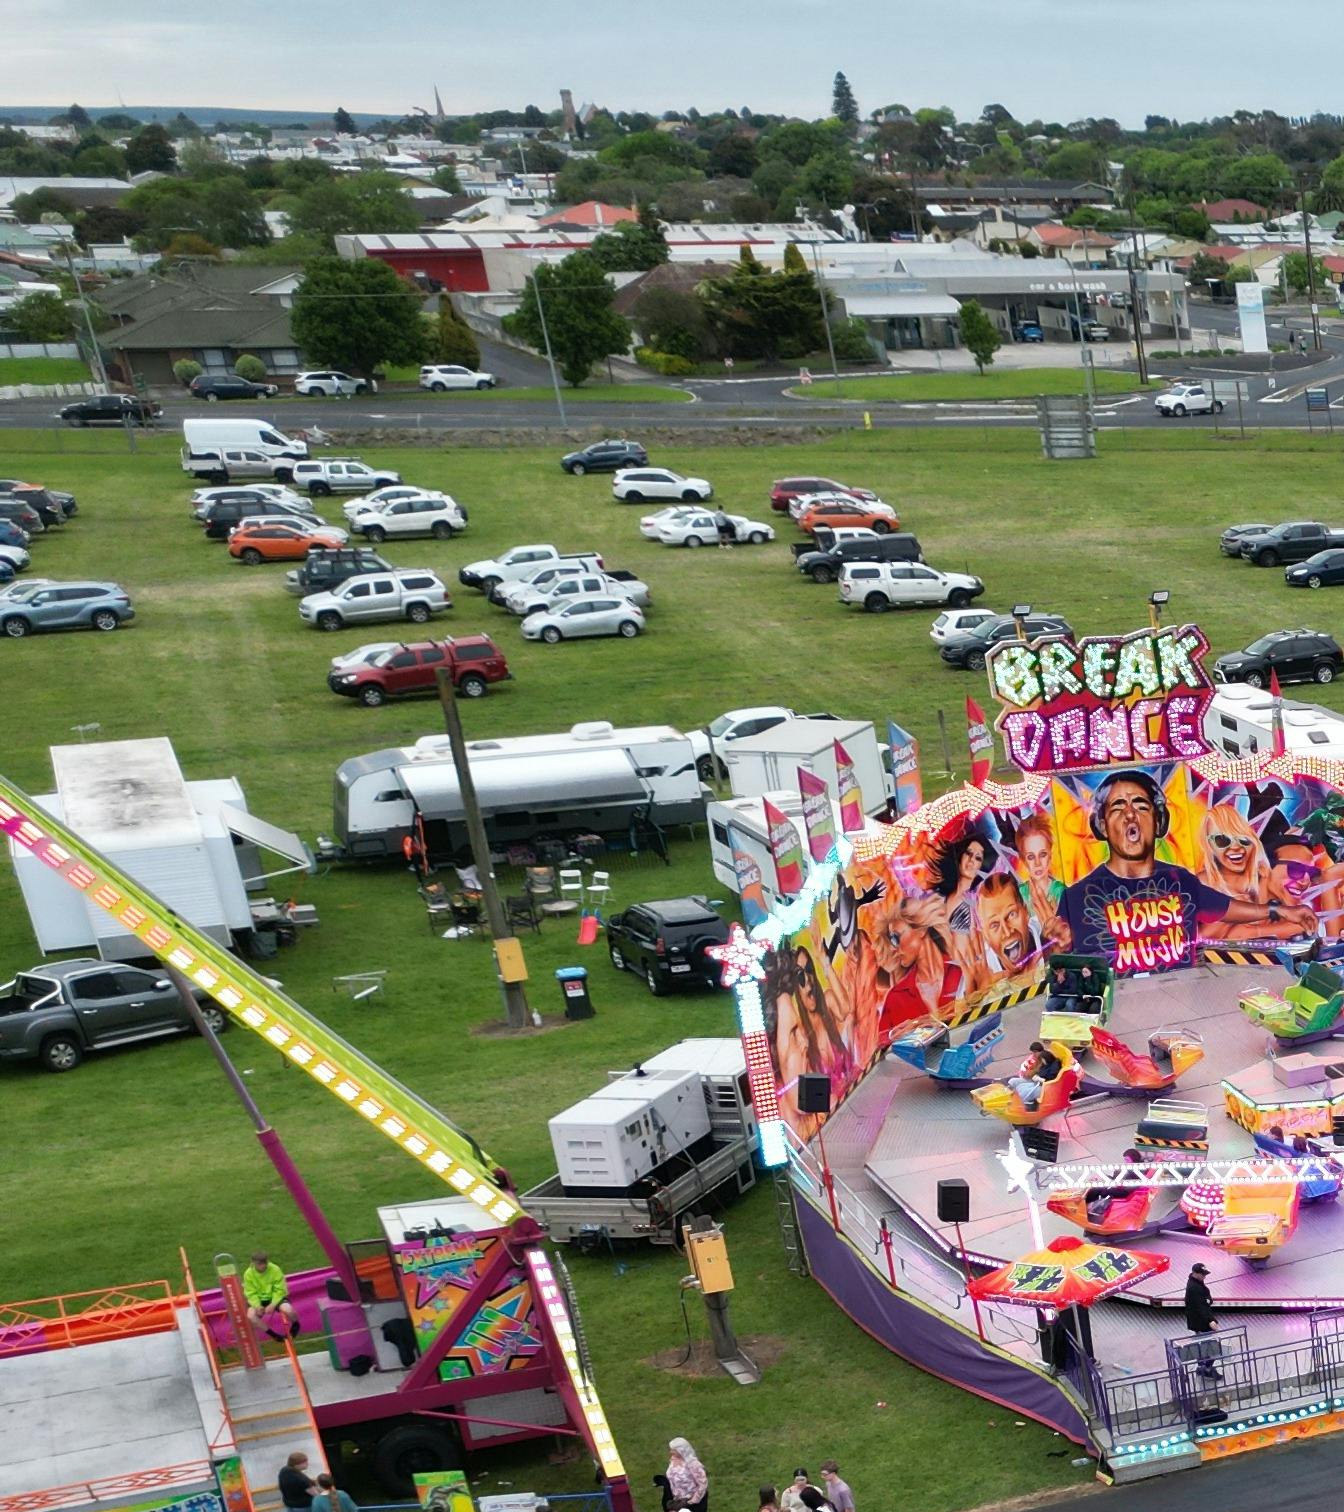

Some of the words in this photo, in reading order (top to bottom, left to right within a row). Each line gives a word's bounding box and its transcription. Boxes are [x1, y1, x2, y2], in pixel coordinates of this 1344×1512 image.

[992, 634, 1200, 707] BREAK
[1002, 696, 1204, 769] DANCE
[1106, 894, 1183, 938] HOUSE
[1116, 924, 1185, 969] MUSIC
